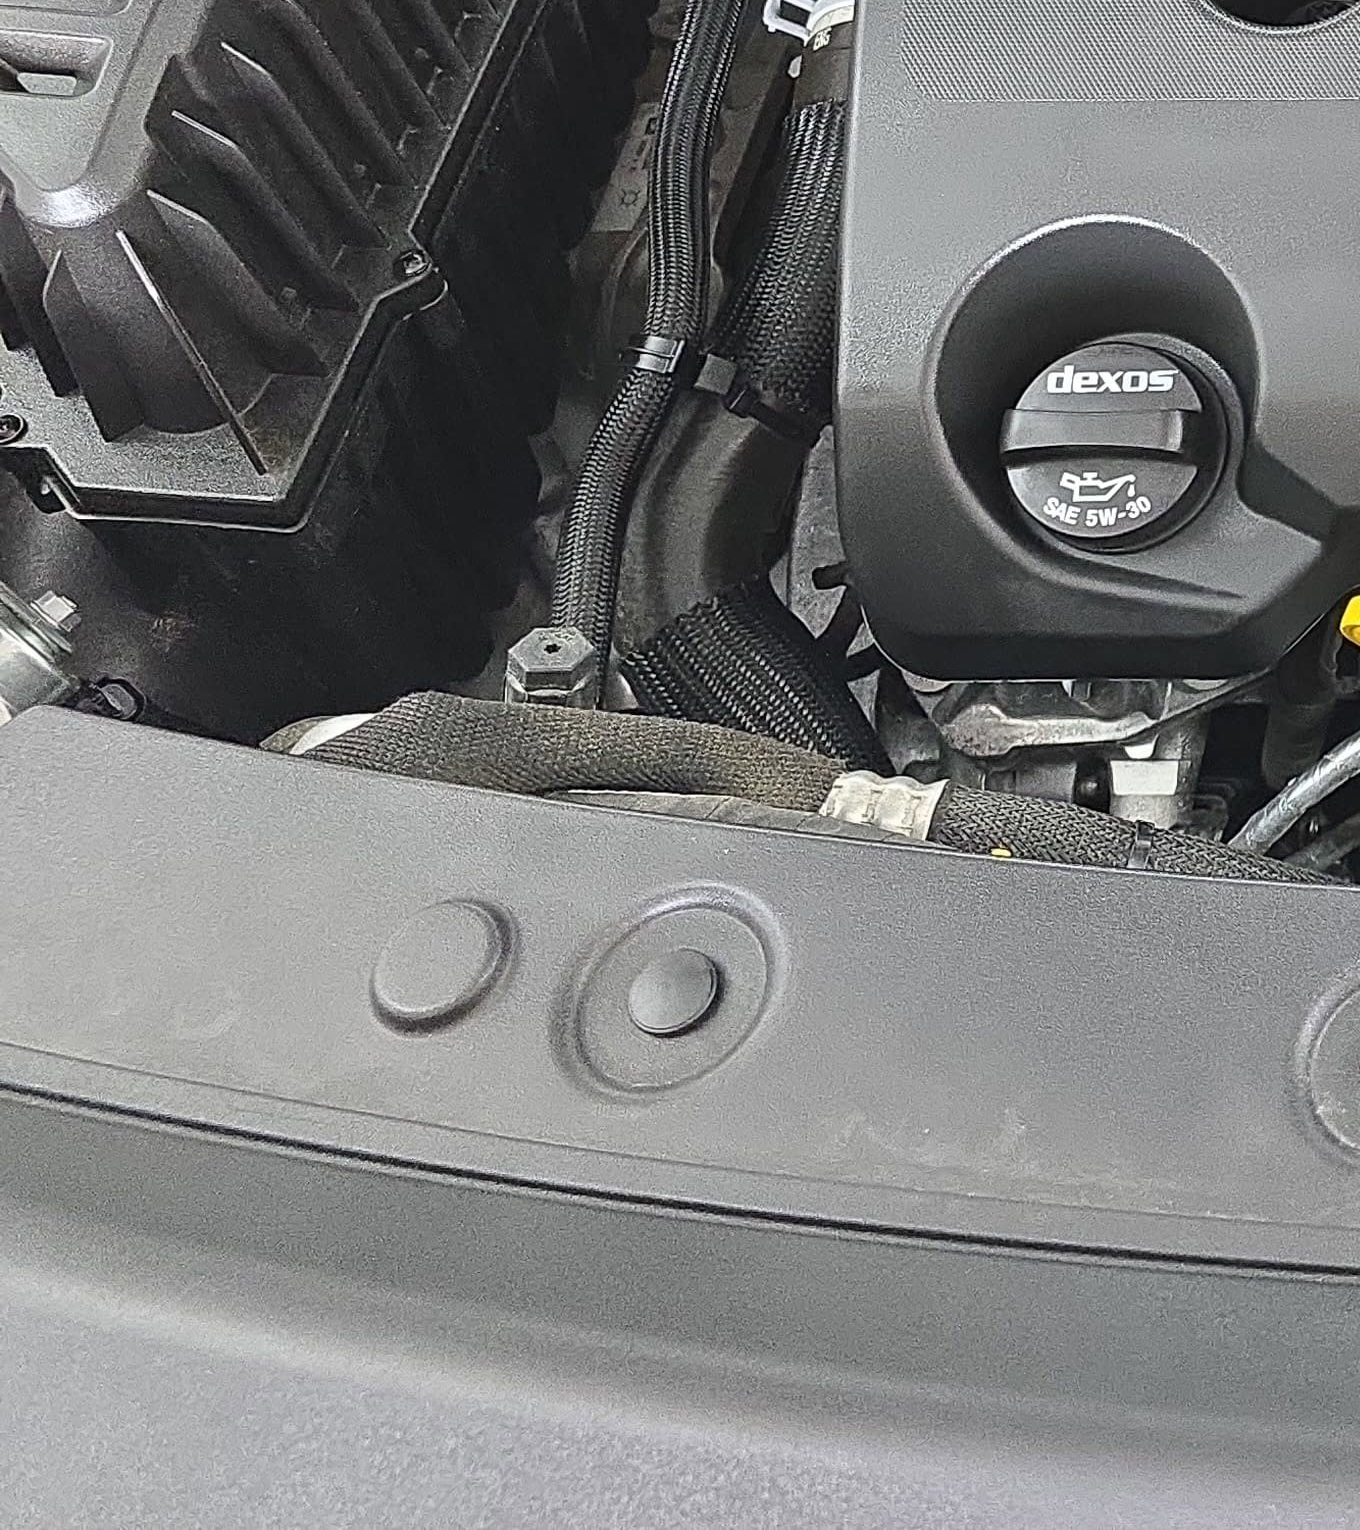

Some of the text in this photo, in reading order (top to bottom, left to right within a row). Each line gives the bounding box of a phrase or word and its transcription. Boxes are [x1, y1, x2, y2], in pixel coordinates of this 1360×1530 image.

[1046, 364, 1180, 394] dexos
[1042, 495, 1152, 528] SAE 5W-30
